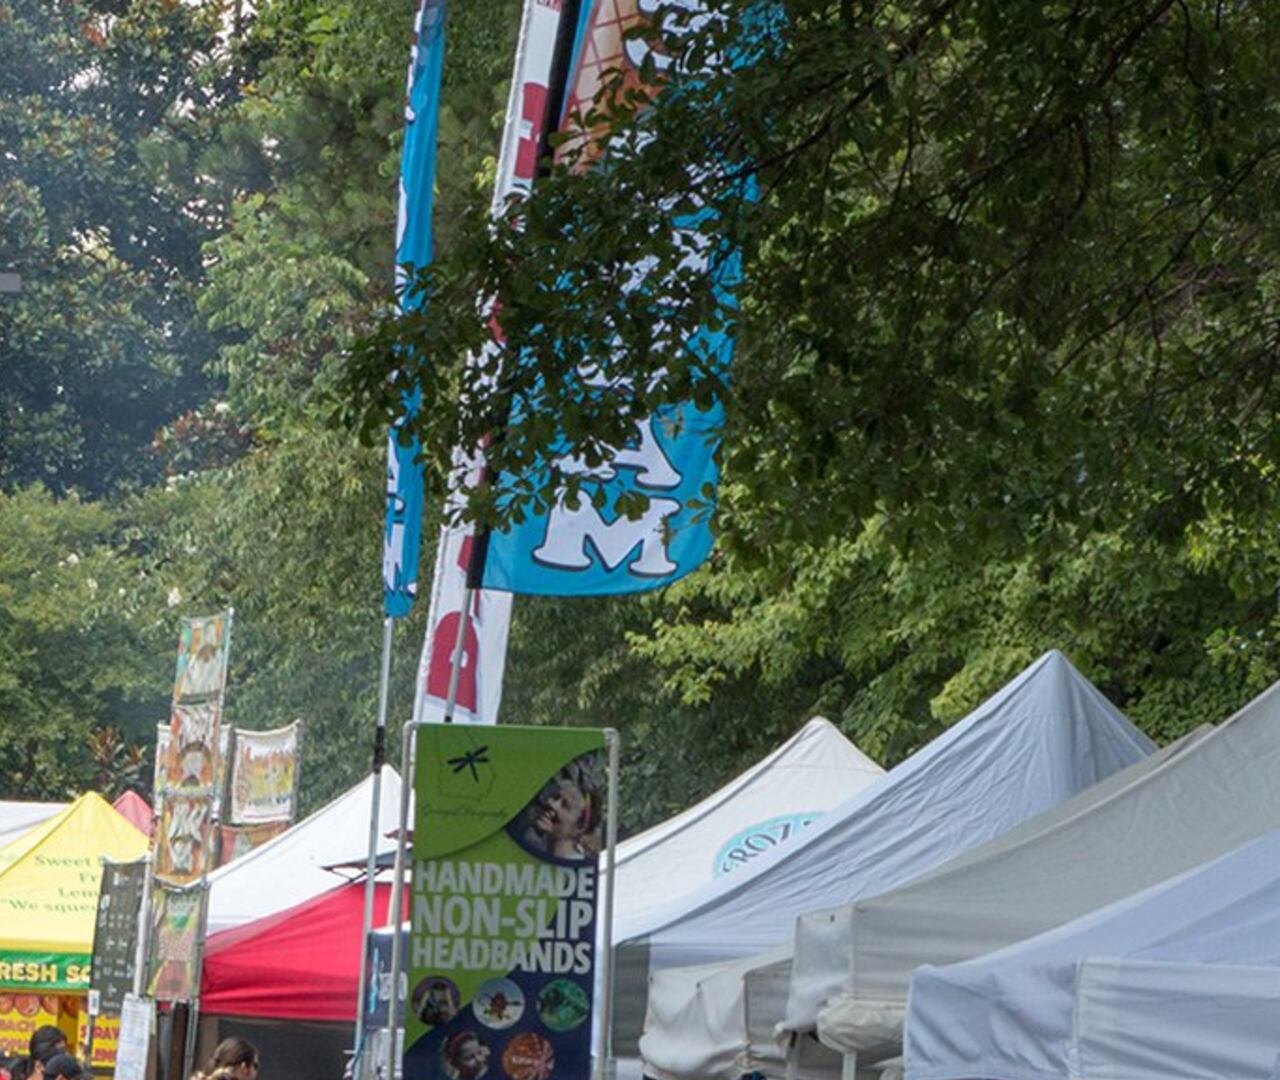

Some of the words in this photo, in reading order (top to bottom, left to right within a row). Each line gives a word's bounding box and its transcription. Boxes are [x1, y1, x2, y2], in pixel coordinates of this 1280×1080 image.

[414, 861, 594, 900] HANDMADE
[412, 896, 593, 942] NON-SLIP
[411, 937, 592, 976] HEADBANDS
